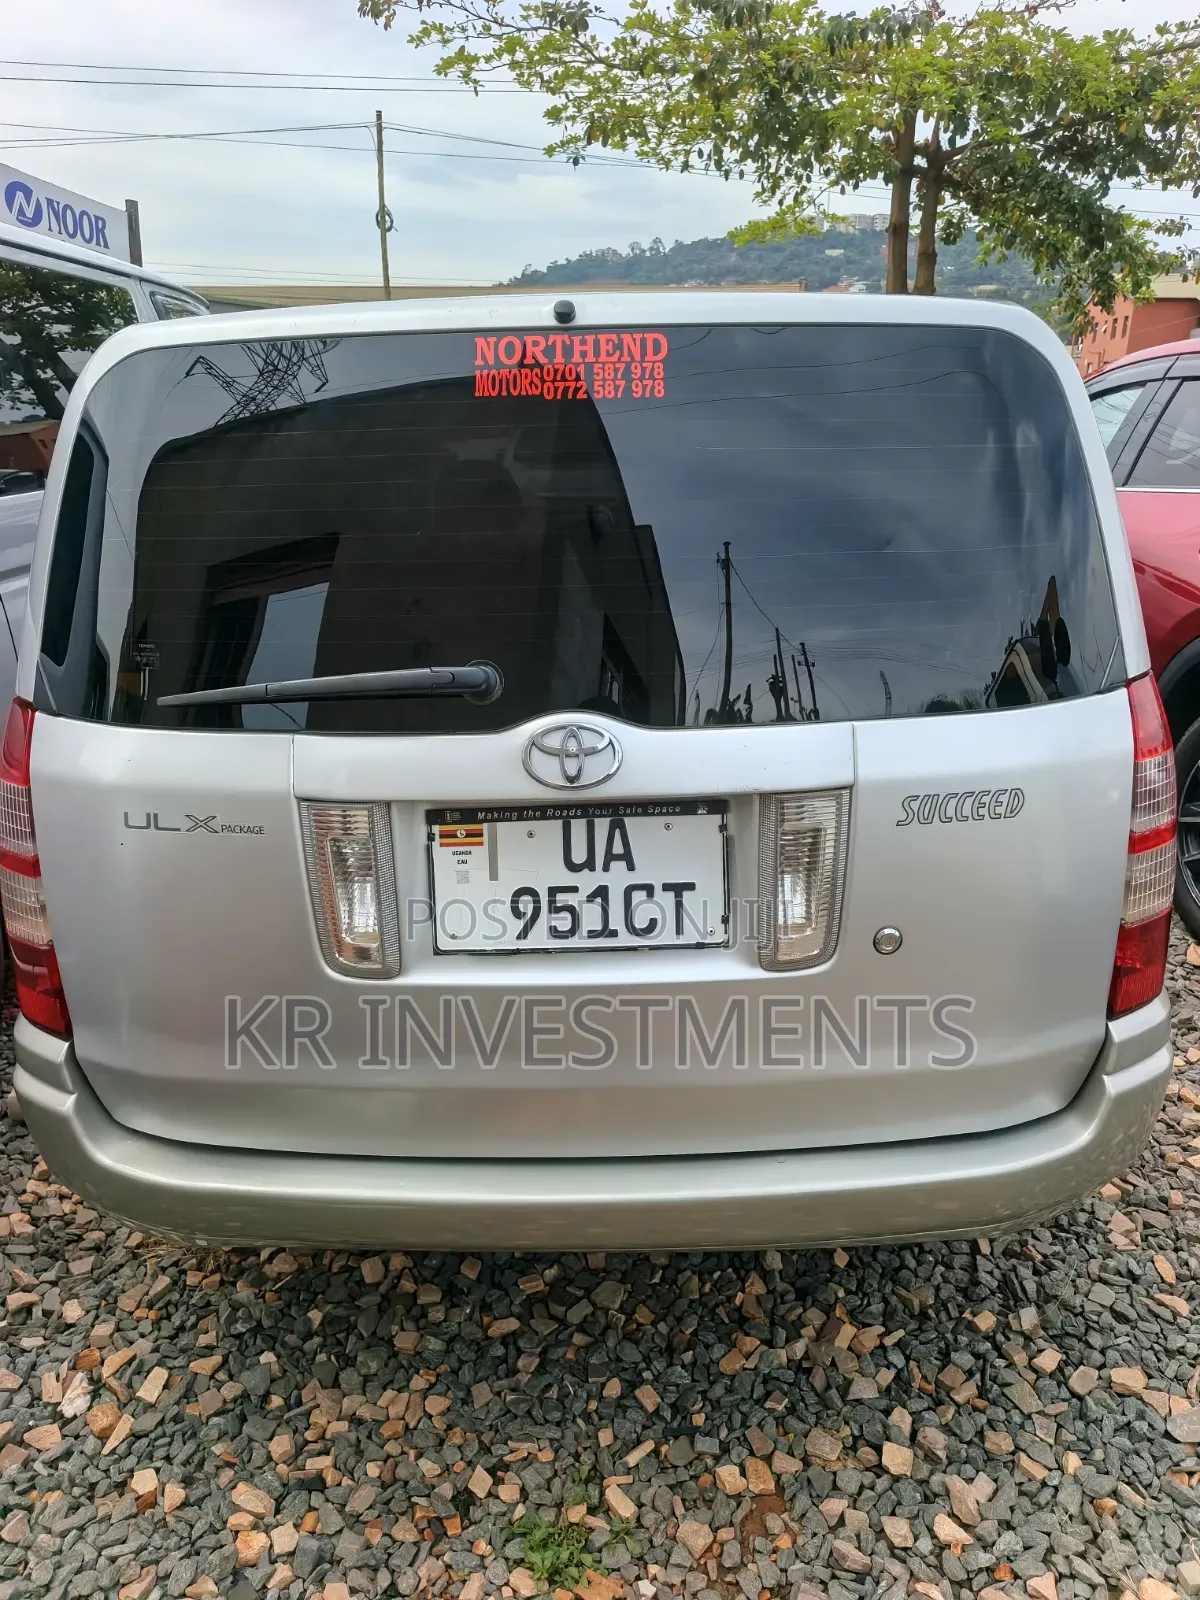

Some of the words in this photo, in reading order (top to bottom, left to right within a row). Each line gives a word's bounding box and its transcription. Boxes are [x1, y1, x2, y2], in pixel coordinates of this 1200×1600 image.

[45, 197, 110, 249] NOOR
[474, 332, 668, 366] NORTHEND
[474, 368, 542, 397] MOTORS
[543, 363, 585, 382] 0701
[593, 363, 626, 380] 587
[631, 361, 664, 379] 978
[543, 381, 588, 400] 0772
[593, 380, 626, 399] 587
[631, 379, 665, 398] 978
[477, 811, 518, 820] Making
[523, 810, 541, 818] the
[546, 808, 582, 817] Roads
[588, 807, 613, 815] Your
[618, 806, 642, 814] Safe
[647, 805, 681, 814] Space
[896, 787, 1025, 827] SUCCEED
[123, 811, 219, 834] ULX
[221, 824, 266, 835] PACKAGE
[561, 817, 636, 873] UA
[510, 881, 697, 941] 951CT
